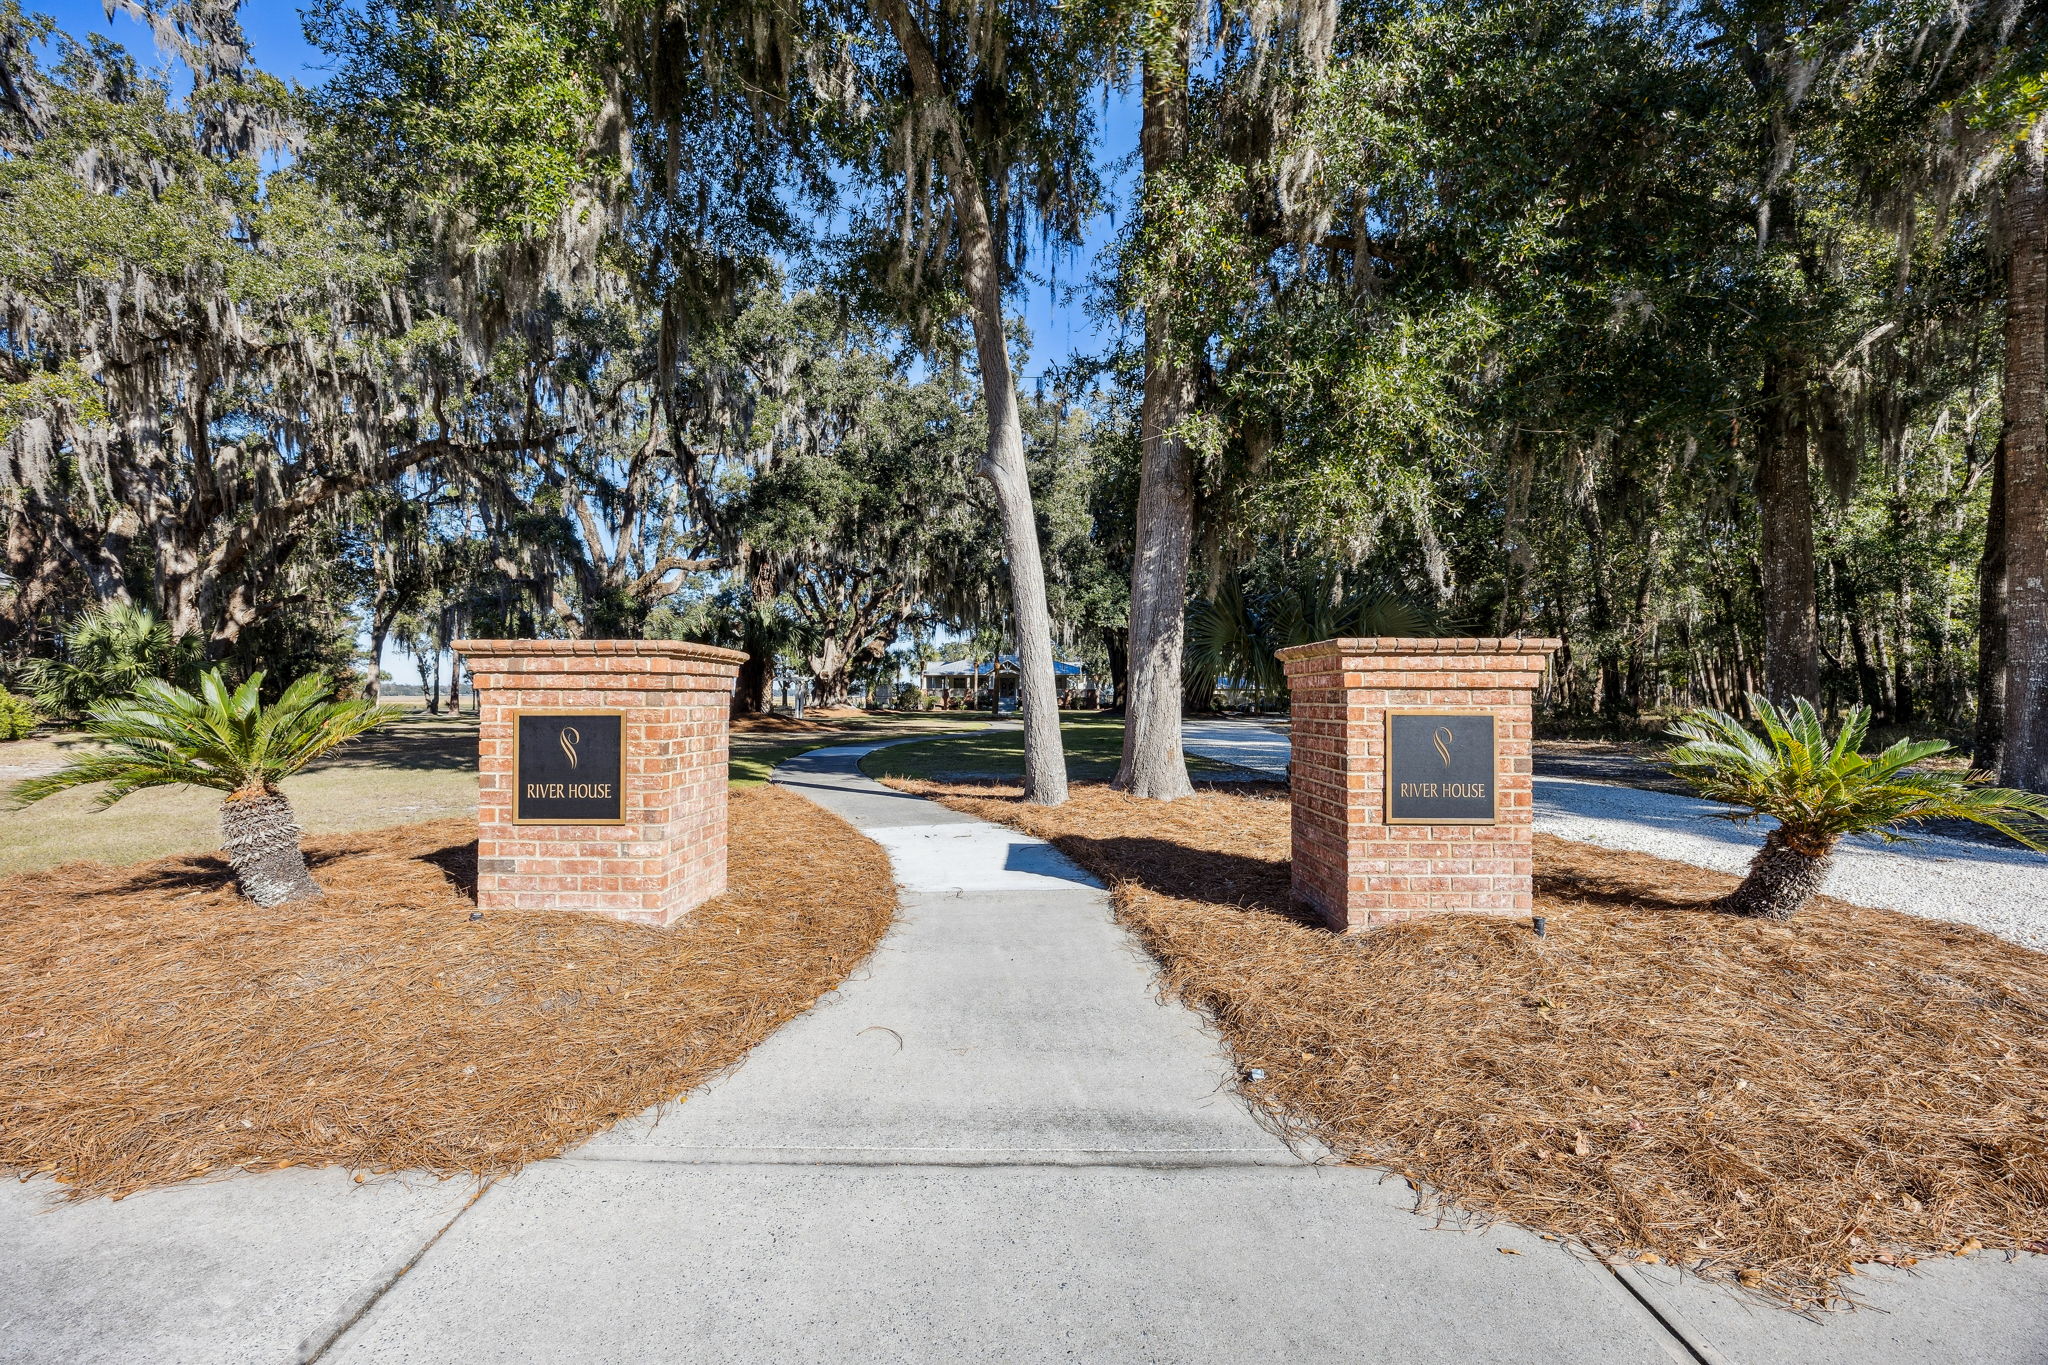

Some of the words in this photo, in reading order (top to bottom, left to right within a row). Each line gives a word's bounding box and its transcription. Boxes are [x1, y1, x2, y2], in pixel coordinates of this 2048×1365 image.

[527, 783, 565, 799] RIVER
[568, 783, 612, 799] HOUSE
[1401, 783, 1438, 798] RIVER
[1442, 783, 1486, 798] HOUSE
